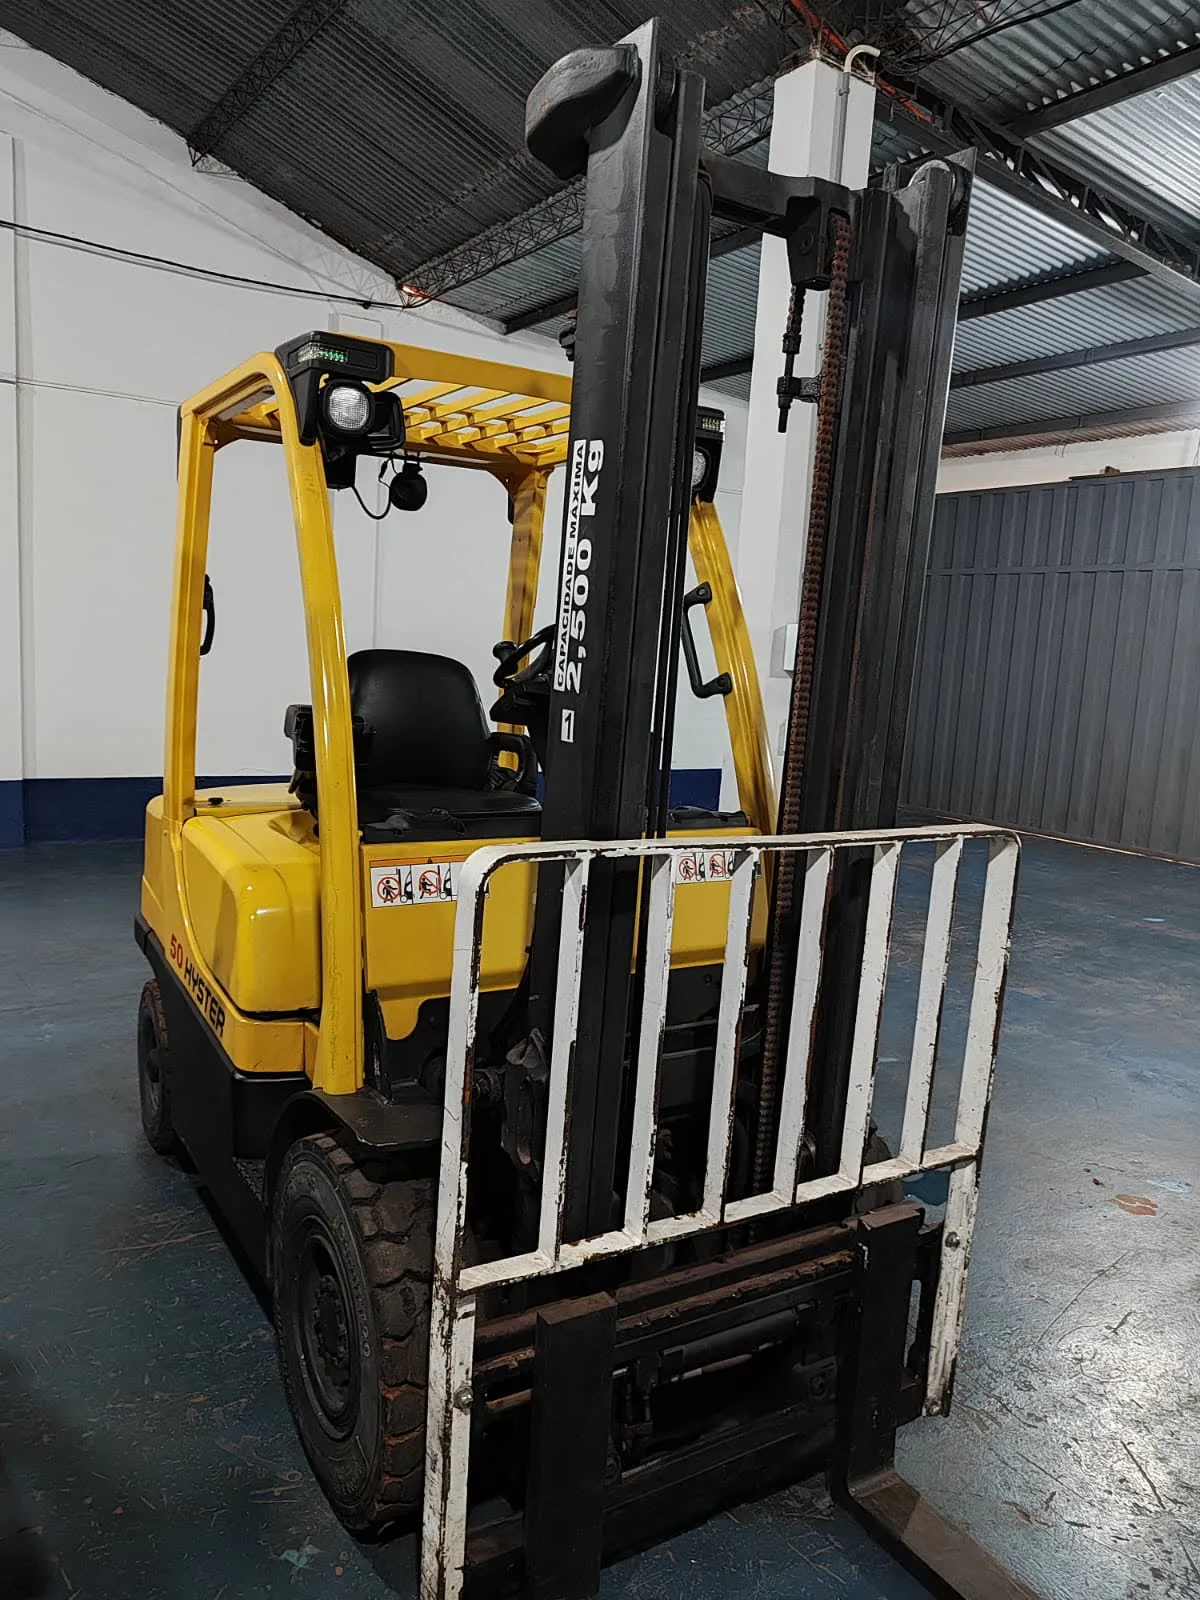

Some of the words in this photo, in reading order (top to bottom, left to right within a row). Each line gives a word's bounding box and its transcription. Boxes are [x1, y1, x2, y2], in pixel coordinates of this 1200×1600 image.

[557, 547, 574, 687] CAPACIDADE
[566, 538, 592, 694] 2,500
[581, 439, 604, 516] Kg
[563, 710, 573, 741] 1
[170, 933, 183, 969] 50
[184, 956, 226, 1038] HYSTER
